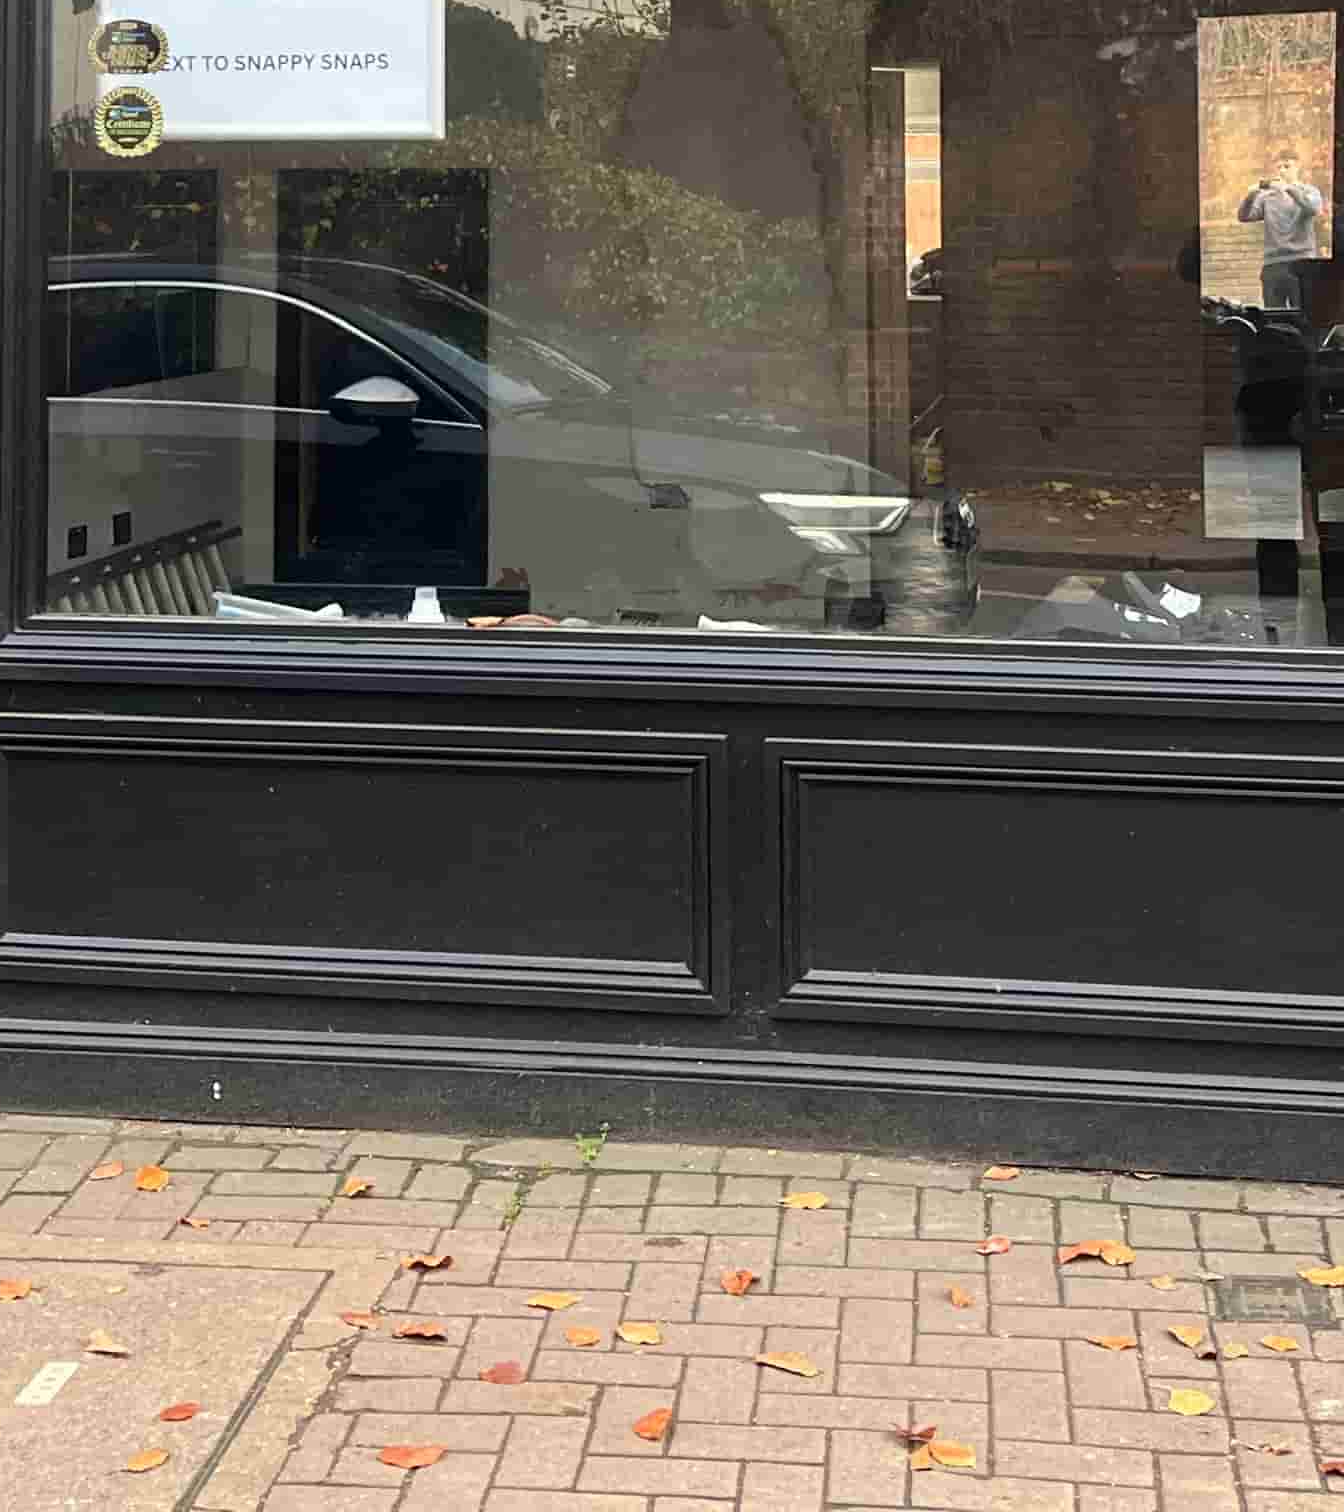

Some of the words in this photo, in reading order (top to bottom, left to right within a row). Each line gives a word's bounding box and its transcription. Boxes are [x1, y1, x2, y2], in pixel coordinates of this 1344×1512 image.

[202, 55, 229, 71] TO
[234, 54, 314, 71] SNAPPY
[320, 52, 390, 70] SNAPS
